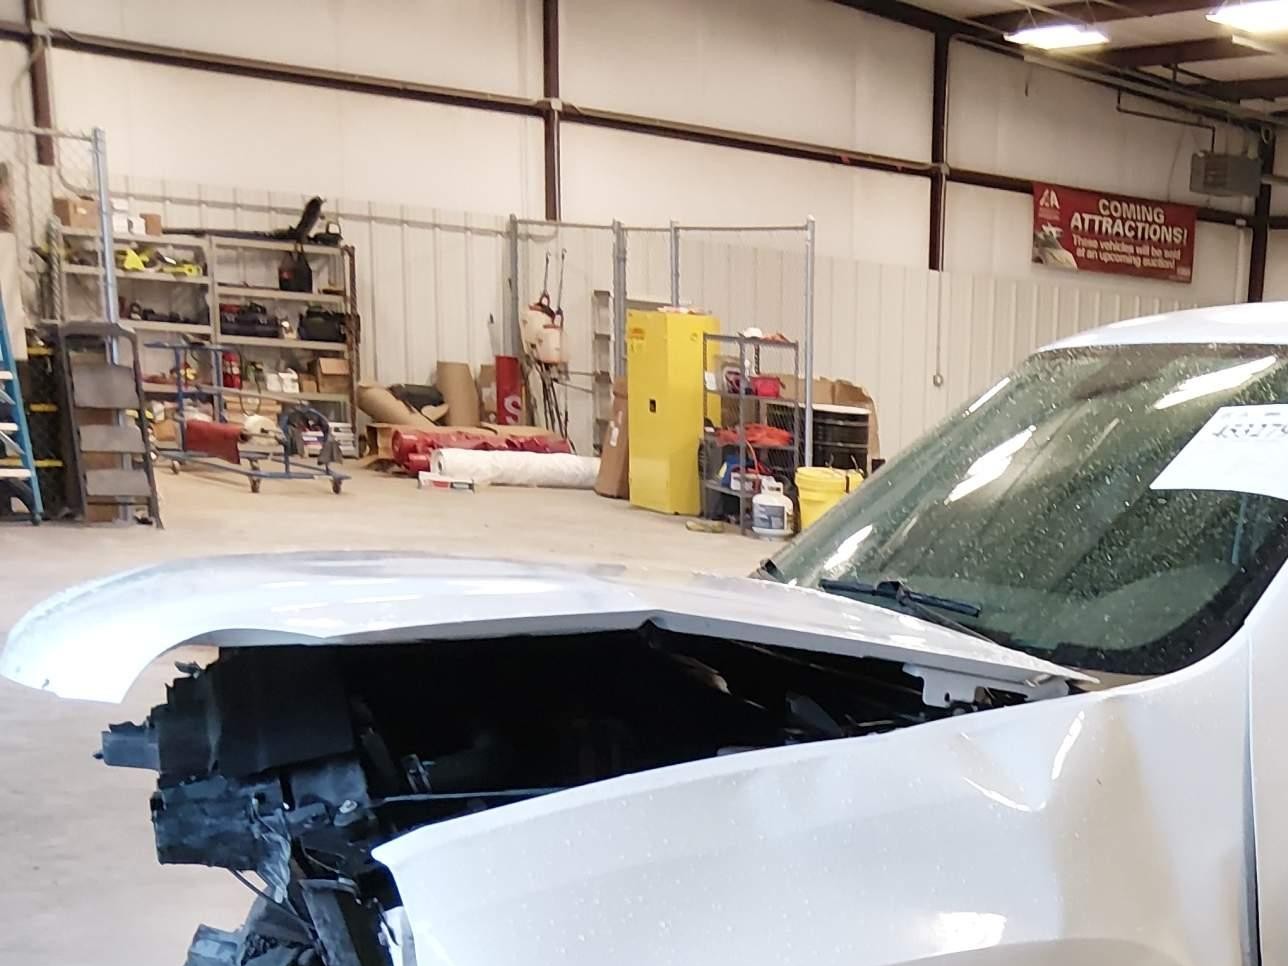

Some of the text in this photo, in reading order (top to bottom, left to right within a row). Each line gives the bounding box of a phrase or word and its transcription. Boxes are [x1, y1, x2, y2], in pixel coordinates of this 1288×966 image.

[1098, 198, 1165, 224] COMING
[1070, 212, 1188, 246] ATTRACTIONS!
[1099, 240, 1135, 254] vehicles
[1086, 250, 1098, 259] an
[1099, 251, 1142, 268] upcoming
